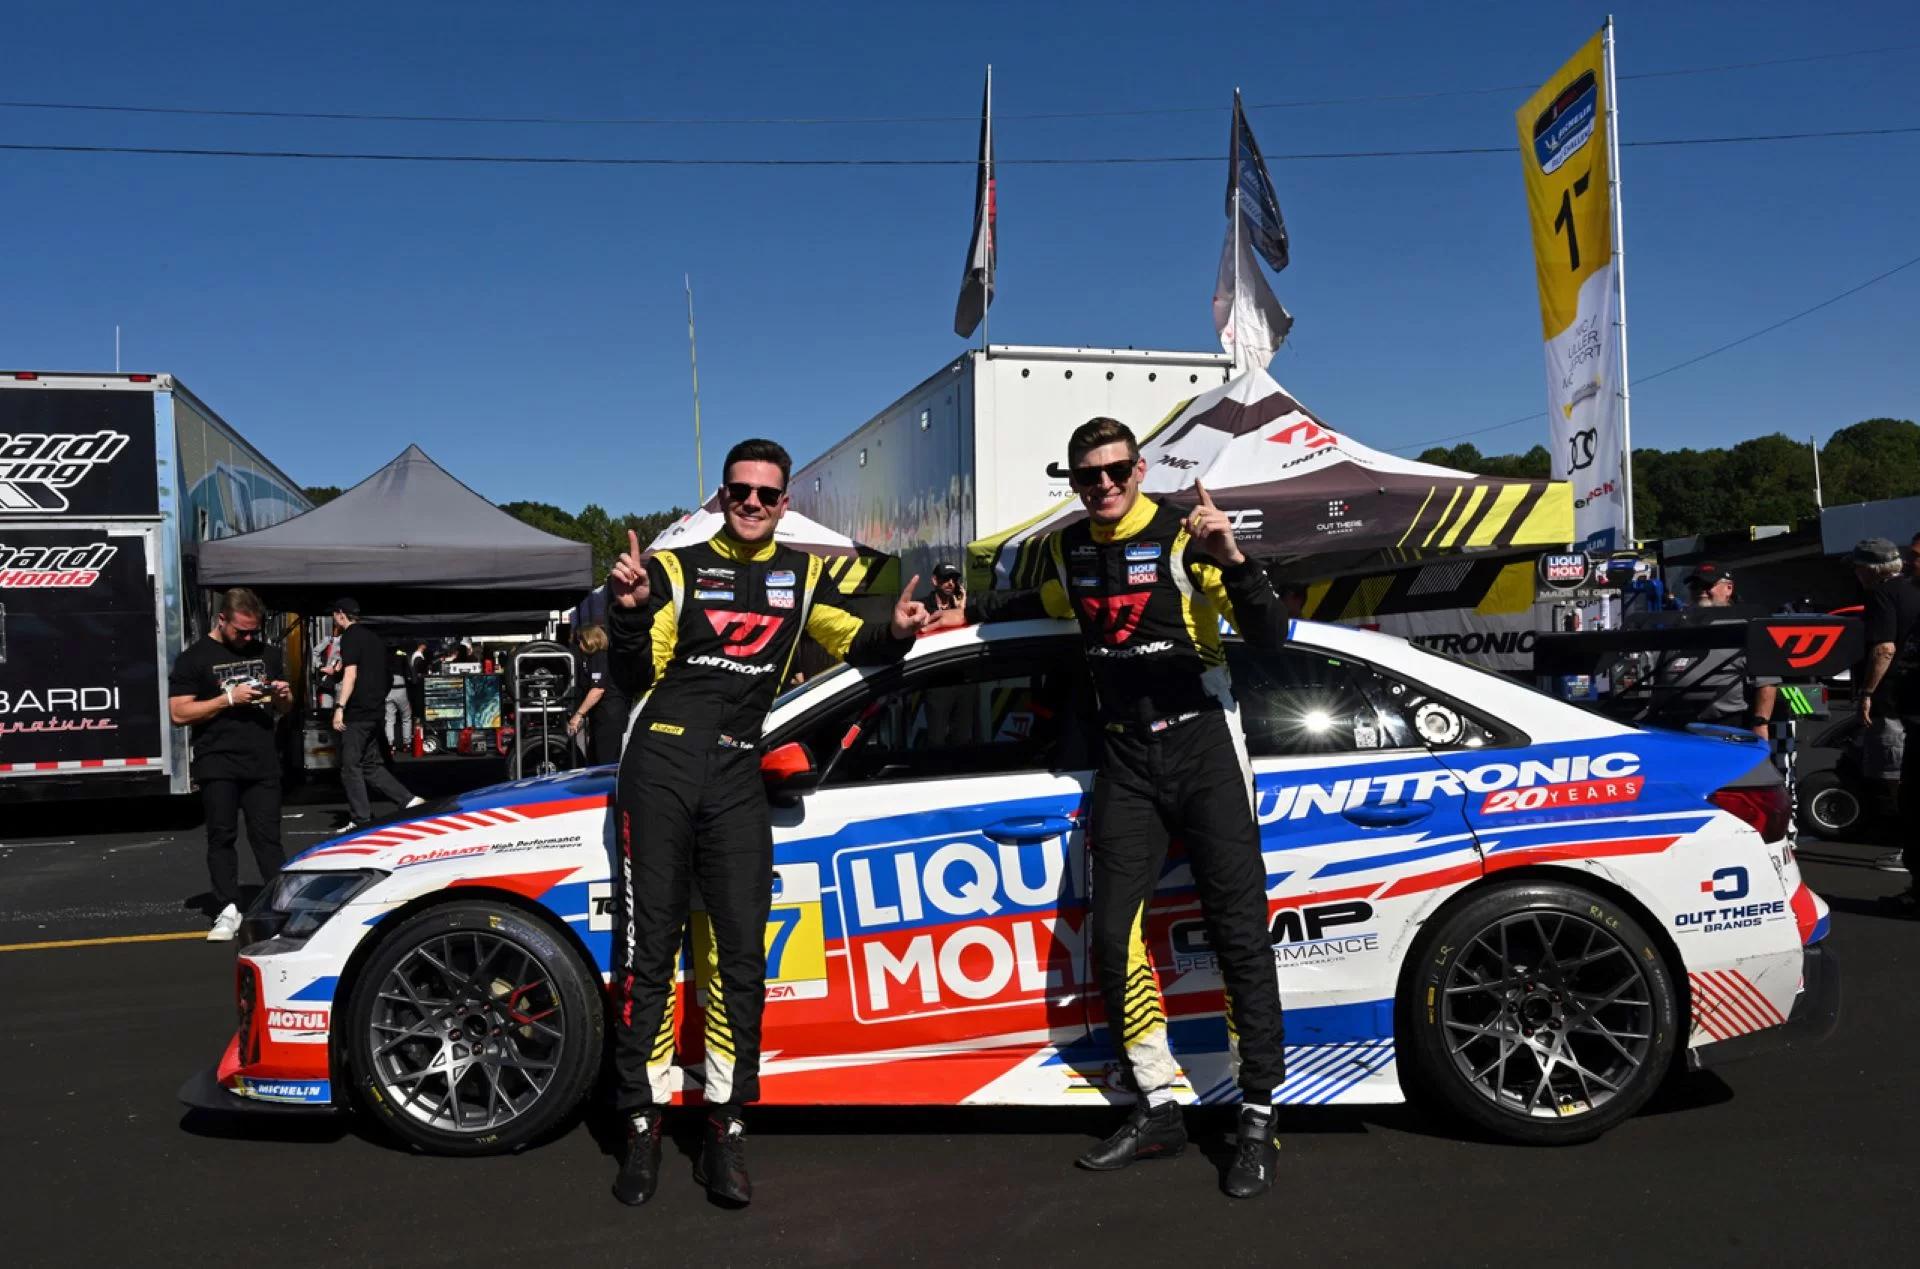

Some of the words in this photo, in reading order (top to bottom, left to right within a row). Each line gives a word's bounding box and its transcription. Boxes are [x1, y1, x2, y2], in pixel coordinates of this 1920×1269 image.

[0, 430, 130, 463] ardi
[0, 460, 93, 488] ing
[1128, 563, 1157, 575] LIQUI
[1550, 556, 1581, 566] LIQUI
[1128, 574, 1158, 585] MOLY
[1550, 567, 1583, 577] MOLY
[0, 716, 118, 736] nature
[1257, 752, 1641, 826] UNITRONIC
[1486, 786, 1549, 812] 20
[1549, 782, 1637, 803] YEARS
[491, 842, 514, 851] High
[516, 835, 581, 847] Performance
[1675, 910, 1717, 926] OUT
[1721, 901, 1785, 920] THERE
[1704, 918, 1763, 933] BRANDS
[863, 914, 1094, 1012] MOLY
[267, 1011, 326, 1028] MOTUL
[258, 1084, 320, 1097] MICHELIN
